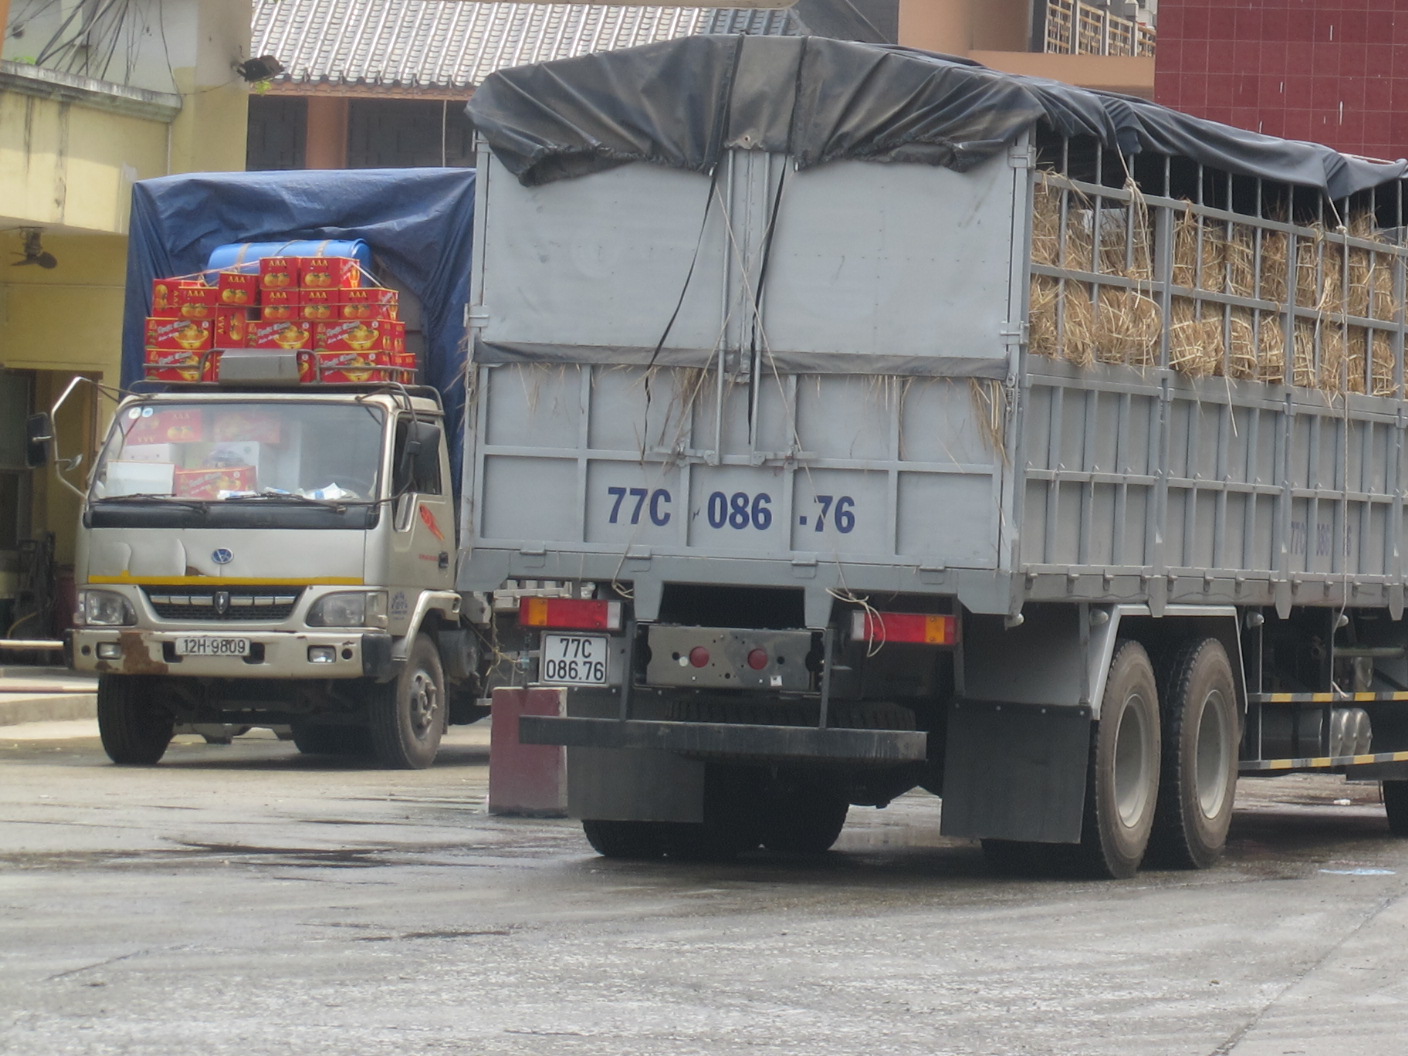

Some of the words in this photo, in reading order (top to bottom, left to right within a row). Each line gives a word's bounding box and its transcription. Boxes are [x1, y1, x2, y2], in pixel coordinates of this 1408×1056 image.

[268, 259, 287, 267] AAA
[228, 275, 246, 283] AAA
[269, 291, 287, 299] AAA
[607, 486, 672, 527] 77C
[707, 491, 772, 531] 086
[184, 639, 246, 654] 12H-9809
[560, 638, 592, 659] 77C
[546, 659, 604, 681] 086.76
